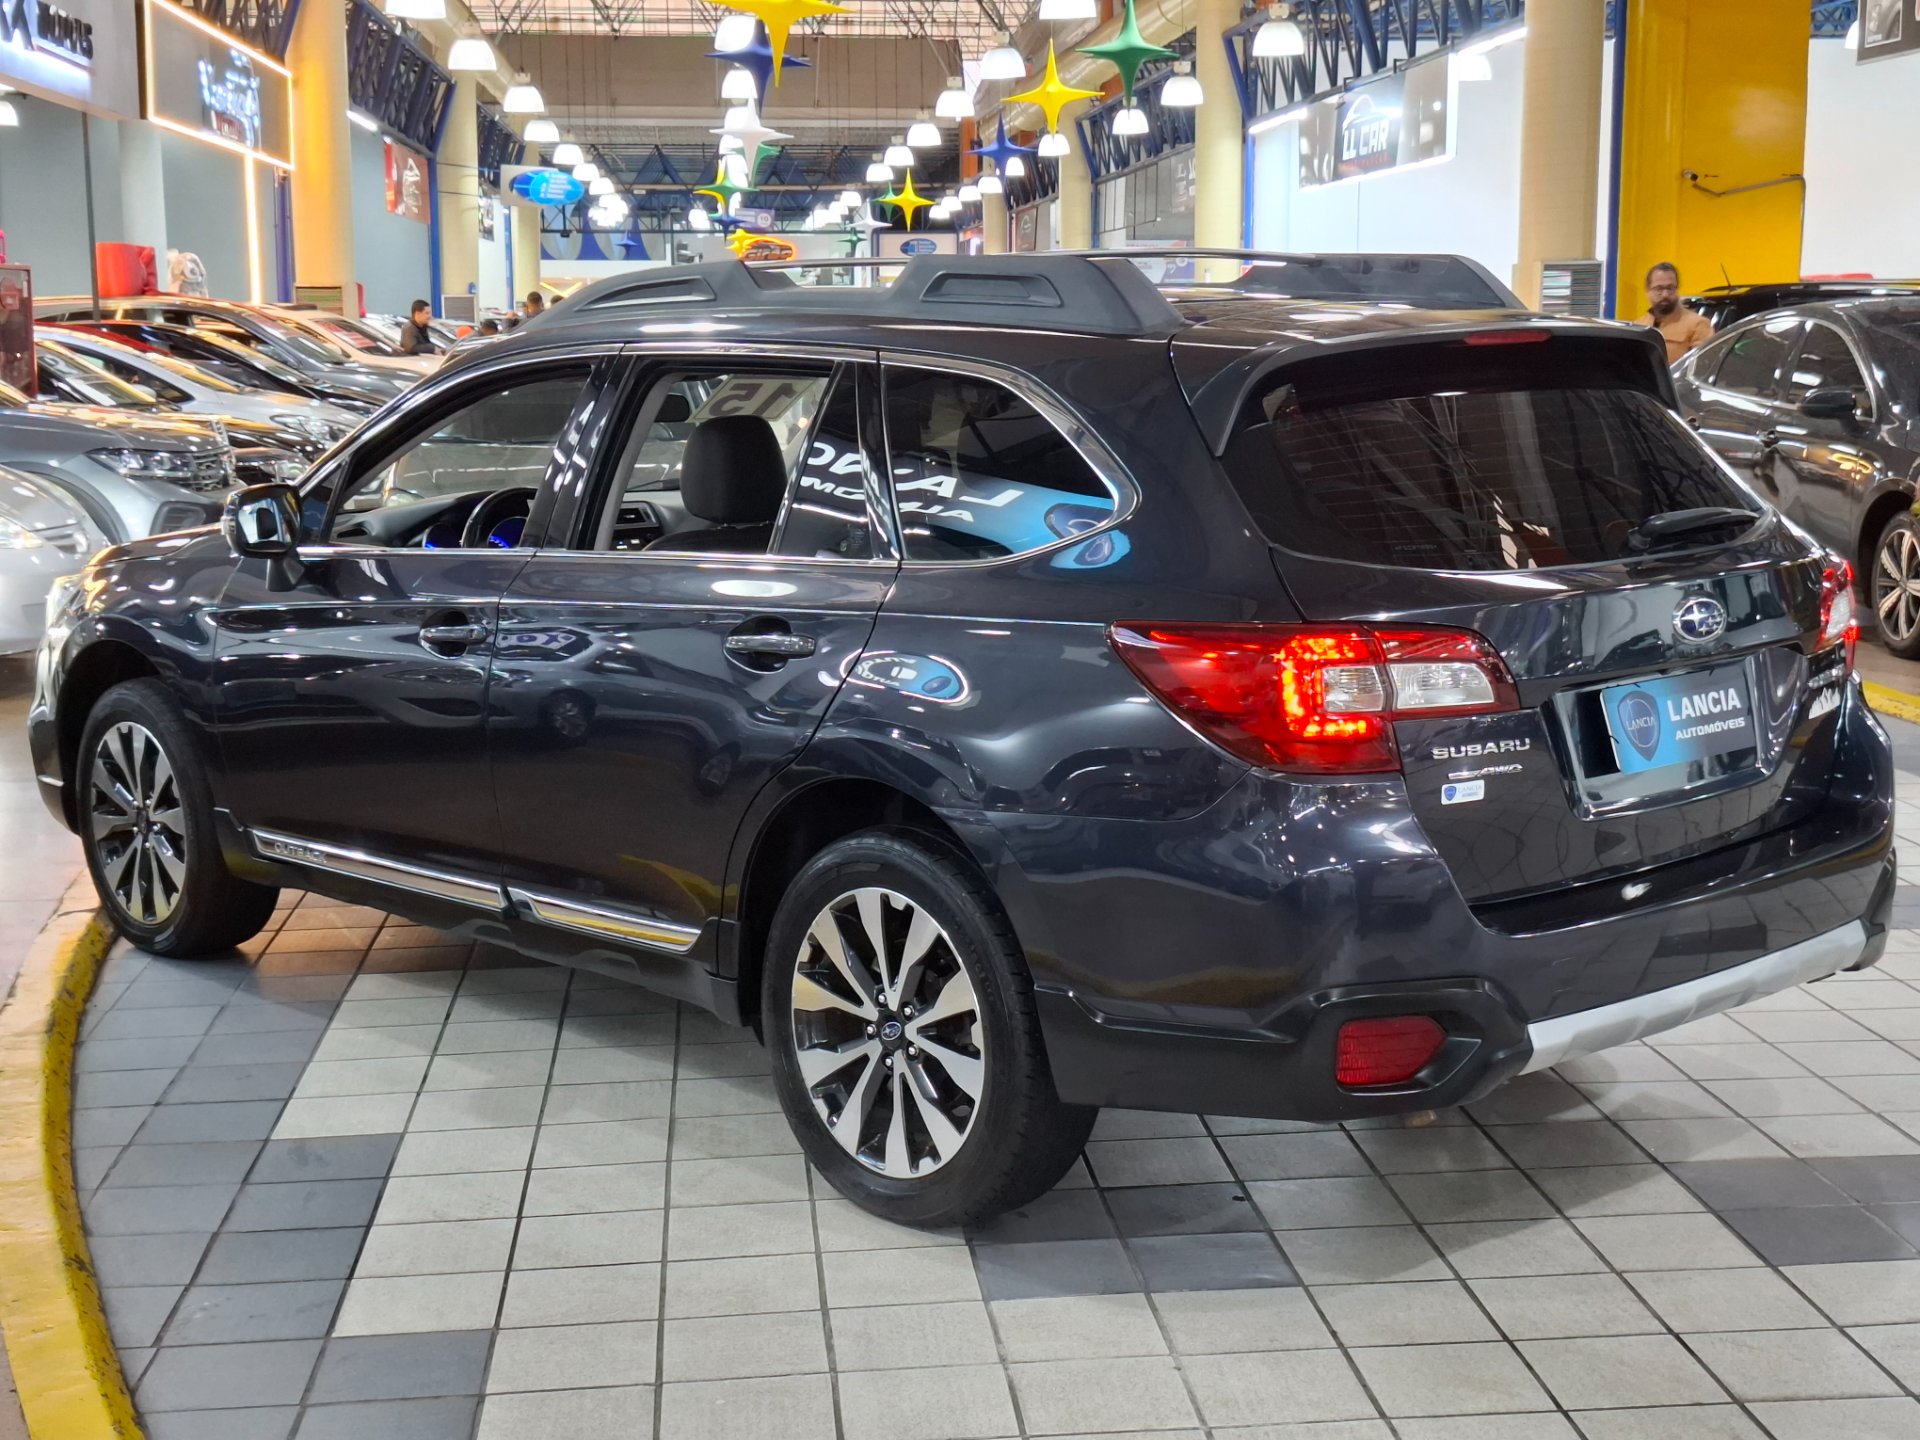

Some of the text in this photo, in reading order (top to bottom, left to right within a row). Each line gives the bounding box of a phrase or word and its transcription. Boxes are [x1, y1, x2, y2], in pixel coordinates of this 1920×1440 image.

[1342, 128, 1356, 161] LL
[1359, 118, 1390, 156] CAR
[1667, 687, 1742, 722] LANCIA
[1626, 716, 1656, 731] LANCIA
[1675, 716, 1746, 741] AUTOMÓVEIS
[1432, 737, 1531, 760] SUBARU
